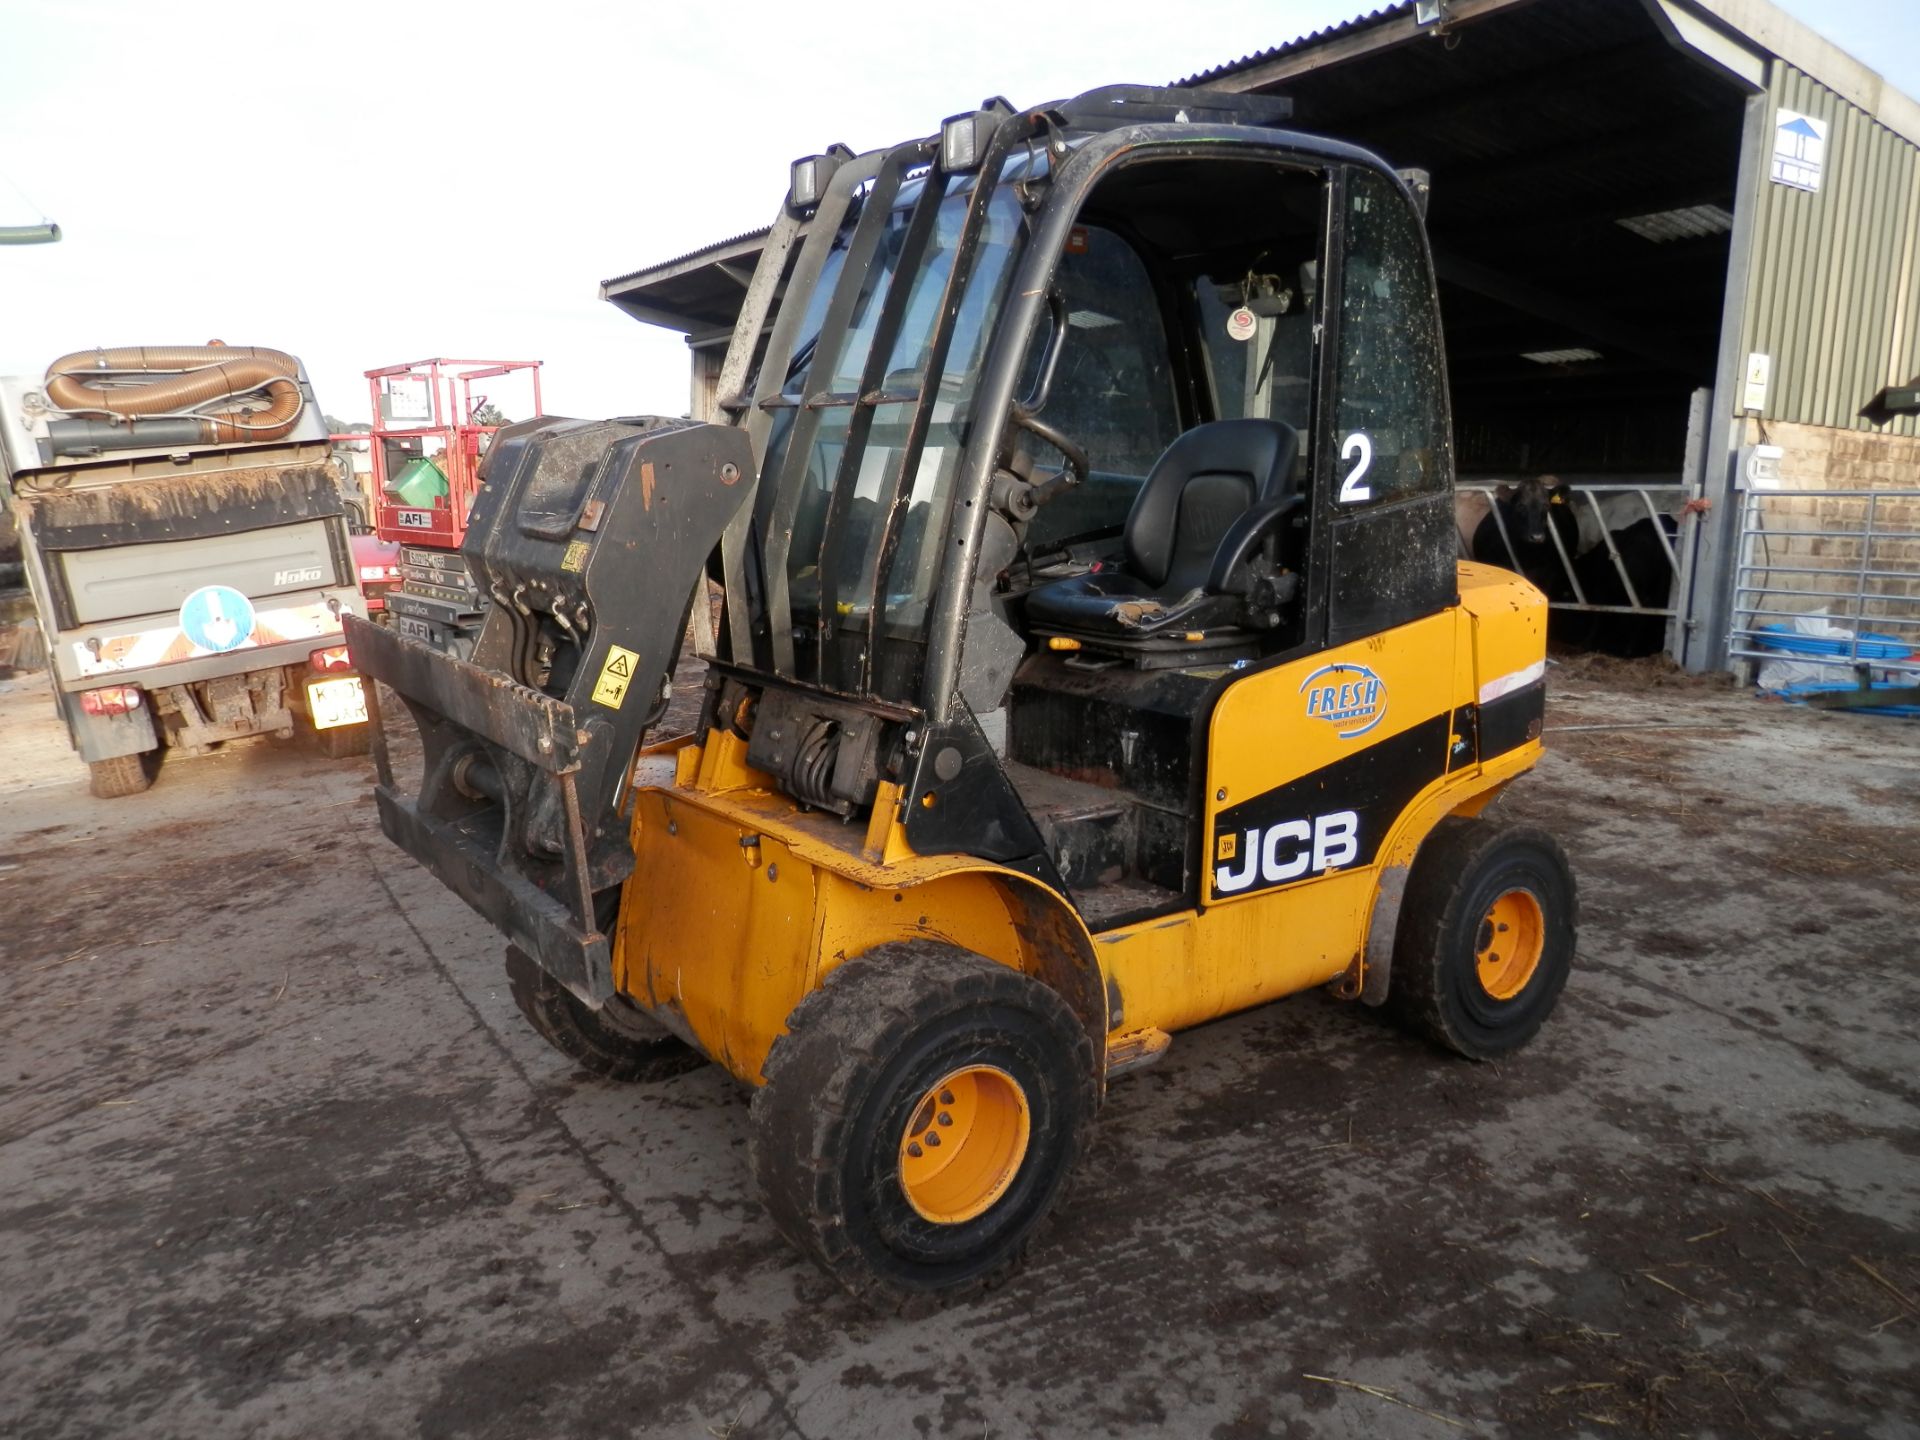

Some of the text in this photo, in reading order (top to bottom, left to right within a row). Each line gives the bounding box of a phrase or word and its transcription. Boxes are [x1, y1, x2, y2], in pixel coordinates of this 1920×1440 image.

[1340, 433, 1371, 502] 2
[405, 513, 423, 526] AFI
[273, 566, 322, 586] Hako
[408, 622, 428, 639] AFI
[1307, 679, 1380, 717] FRESH
[1217, 811, 1358, 892] JCB
